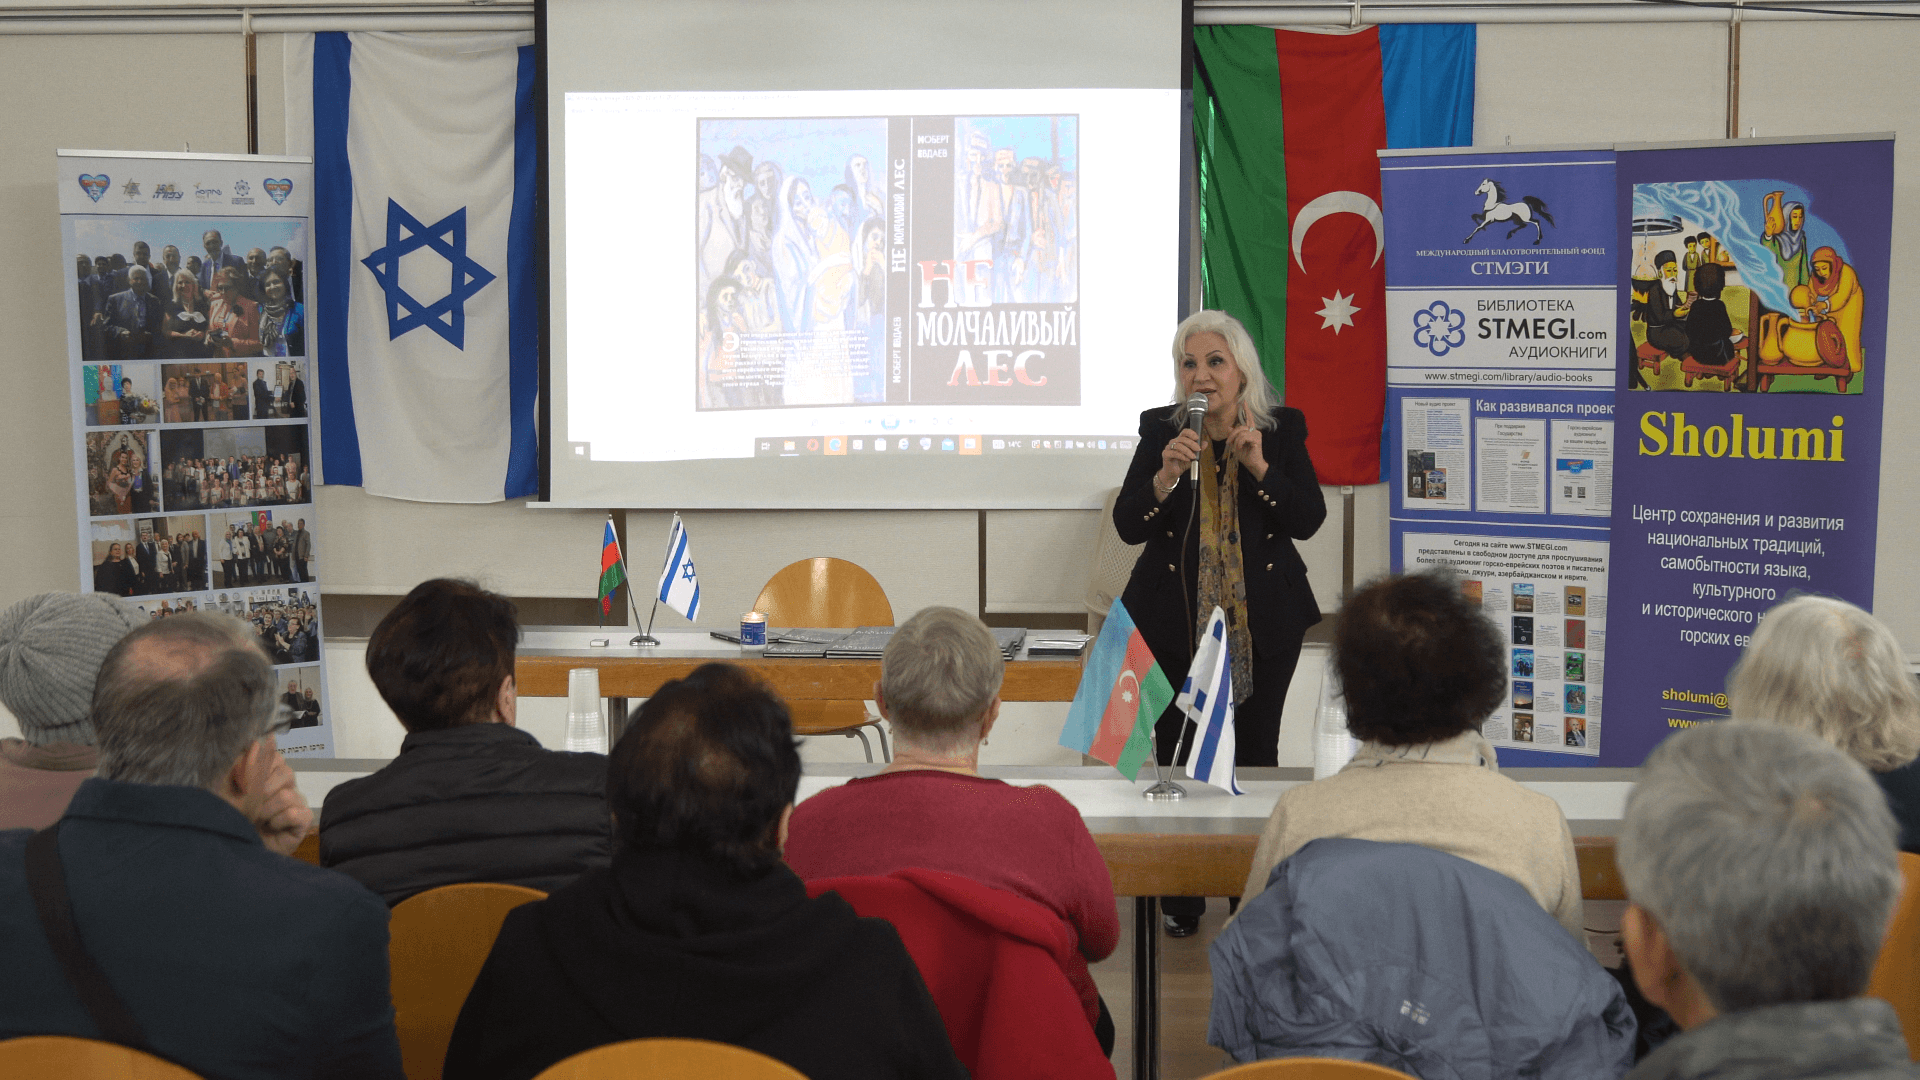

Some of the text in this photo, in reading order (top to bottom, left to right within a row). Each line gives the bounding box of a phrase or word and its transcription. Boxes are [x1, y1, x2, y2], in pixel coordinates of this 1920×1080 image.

[917, 148, 948, 158] ЕВДАЕВ
[891, 158, 907, 273] НЕ МОЛЧАЛИВЫЙ ЛЕС
[1416, 247, 1606, 258] МЕЖДУНАРОДНЫЙ БЛАГОТВОРИТЕЛЬНЫЙ ФОНД
[1470, 261, 1550, 276] СТМЭГИ
[917, 259, 994, 308] НЕ
[1477, 300, 1574, 312] БИБЛИОТЕКА
[916, 305, 1077, 346] МОЛЧАЛИВЫЙ
[1477, 318, 1607, 340] STMEGI.com
[1508, 346, 1607, 360] АУДИОКНИГИ
[946, 350, 1048, 387] ЛЕС
[1424, 372, 1593, 384] www.stmegi.com/library/audio-books
[1476, 400, 1615, 416] Как развивался проек
[1638, 411, 1844, 462] Sholumi
[1632, 504, 1844, 531] Центр сохранения и развития
[1454, 540, 1480, 548] Сегодня
[1510, 543, 1568, 551] www.STMEGI.com
[1648, 531, 1826, 558] национальных традиций,
[1416, 556, 1436, 564] более
[1482, 560, 1540, 569] горско-еврейских
[1572, 564, 1605, 572] писателей
[1418, 548, 1466, 556] представлены
[1552, 554, 1602, 563] прослушивания
[1472, 570, 1496, 578] джуури,
[1498, 570, 1556, 580] азербайджанском
[1564, 574, 1588, 582] иврите.
[1660, 554, 1812, 580] самобытности языка,
[1692, 582, 1776, 602] культурного
[1642, 603, 1650, 614] и
[1655, 605, 1753, 625] исторического
[1680, 629, 1730, 647] горских
[1662, 688, 1732, 709] sholumi@
